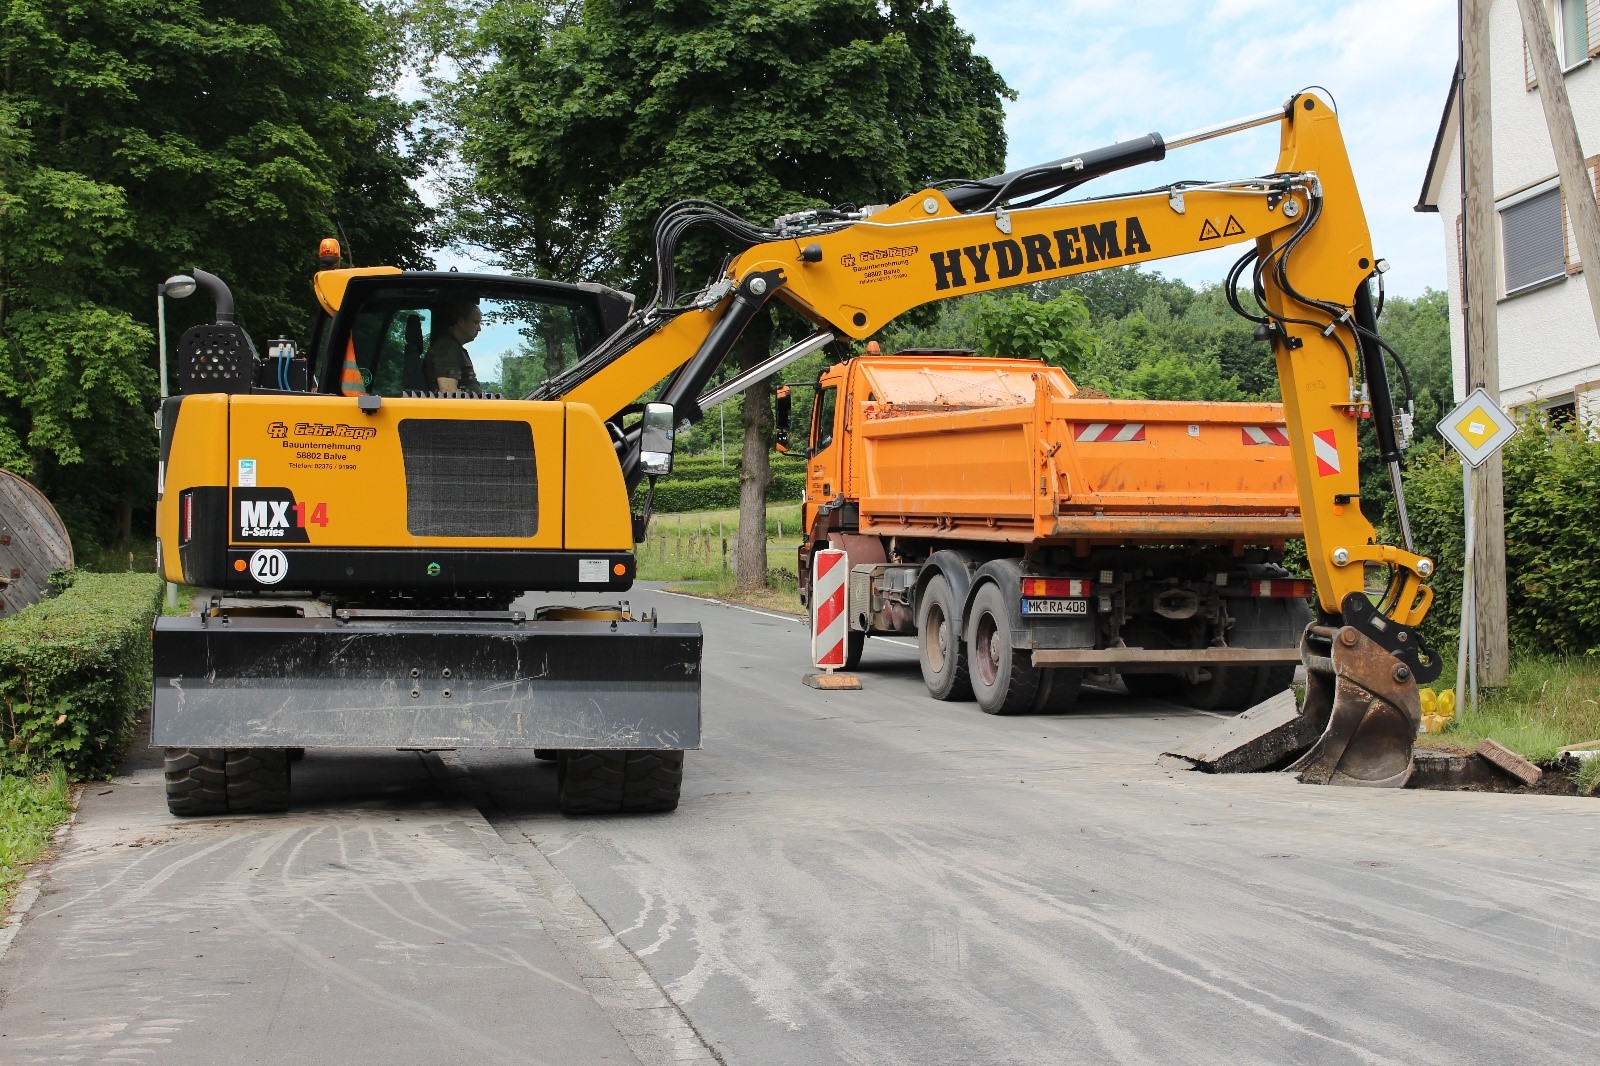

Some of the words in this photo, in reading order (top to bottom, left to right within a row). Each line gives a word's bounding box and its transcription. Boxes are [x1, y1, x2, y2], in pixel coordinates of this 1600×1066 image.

[887, 246, 918, 258] Rapp
[929, 216, 1151, 291] HYDREMA
[294, 422, 333, 437] Gebr.
[333, 424, 377, 440] Rapp
[282, 440, 361, 451] Bauunternehmung
[296, 452, 321, 460] 58802
[323, 452, 347, 460] Balve
[241, 527, 285, 537] G-Series
[257, 555, 279, 577] 20
[1028, 601, 1042, 612] MK
